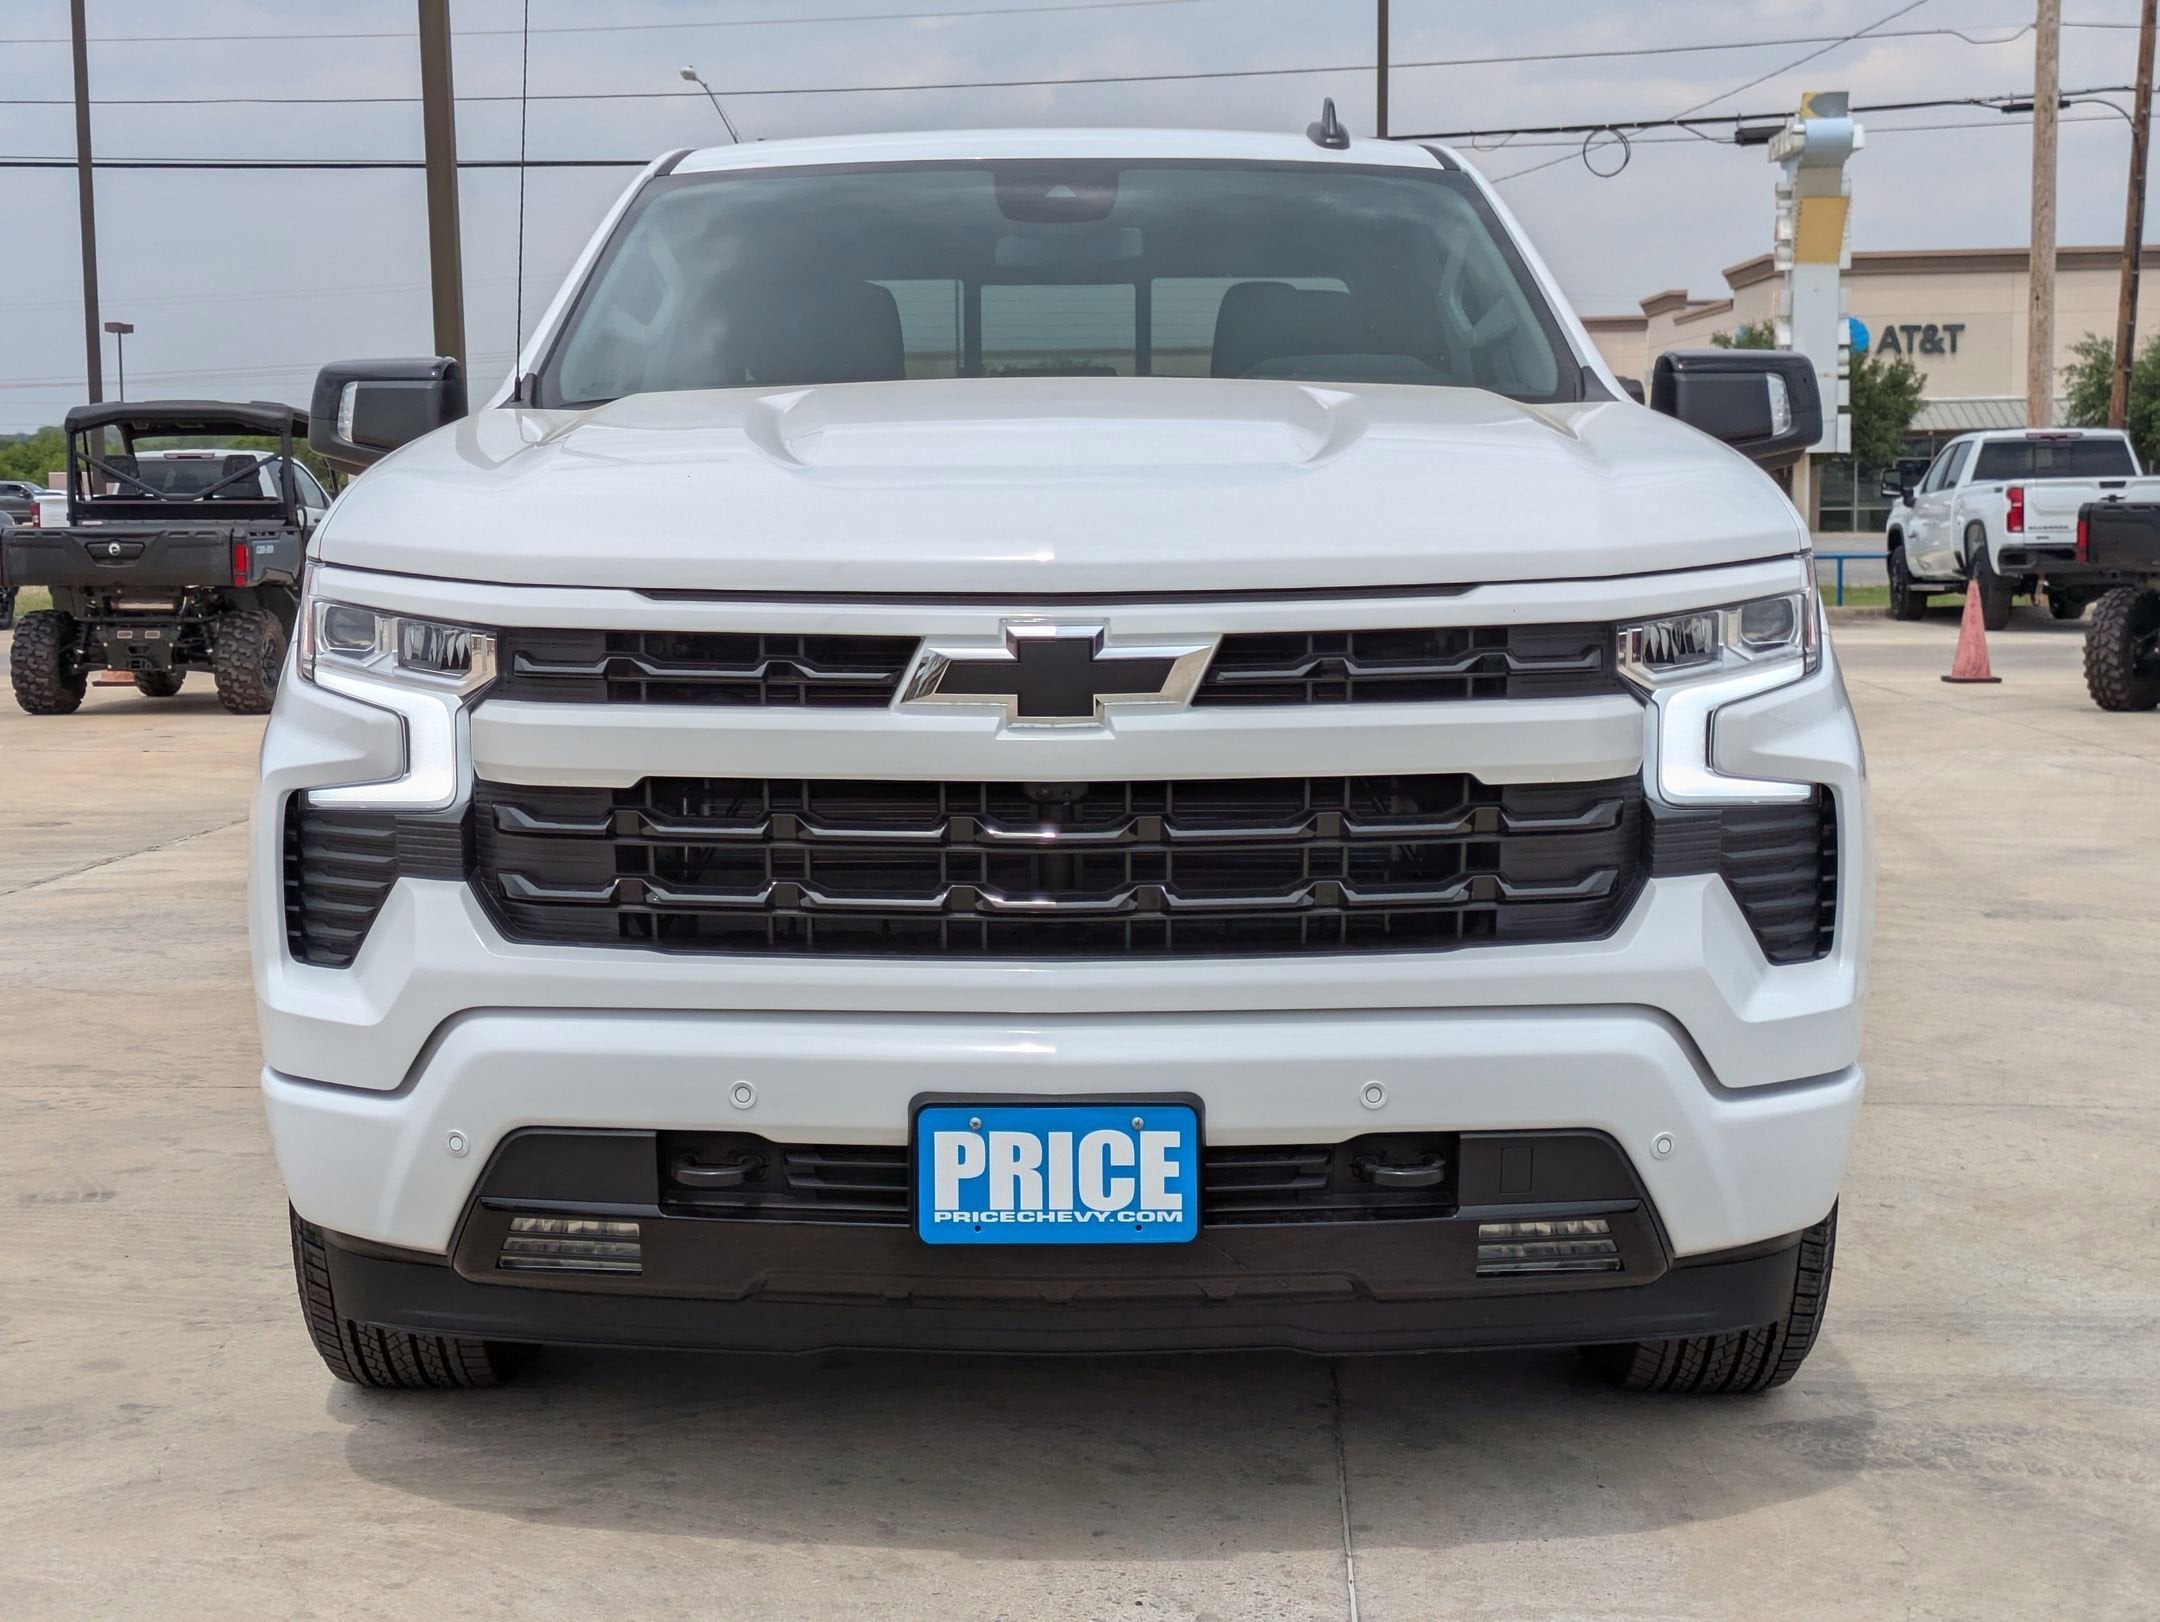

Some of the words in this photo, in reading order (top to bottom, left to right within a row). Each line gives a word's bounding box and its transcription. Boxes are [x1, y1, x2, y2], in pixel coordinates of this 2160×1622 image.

[1876, 324, 1966, 354] AT&T
[934, 1130, 1182, 1211] PRICE
[934, 1211, 1183, 1223] PRICECHEVY.COM
